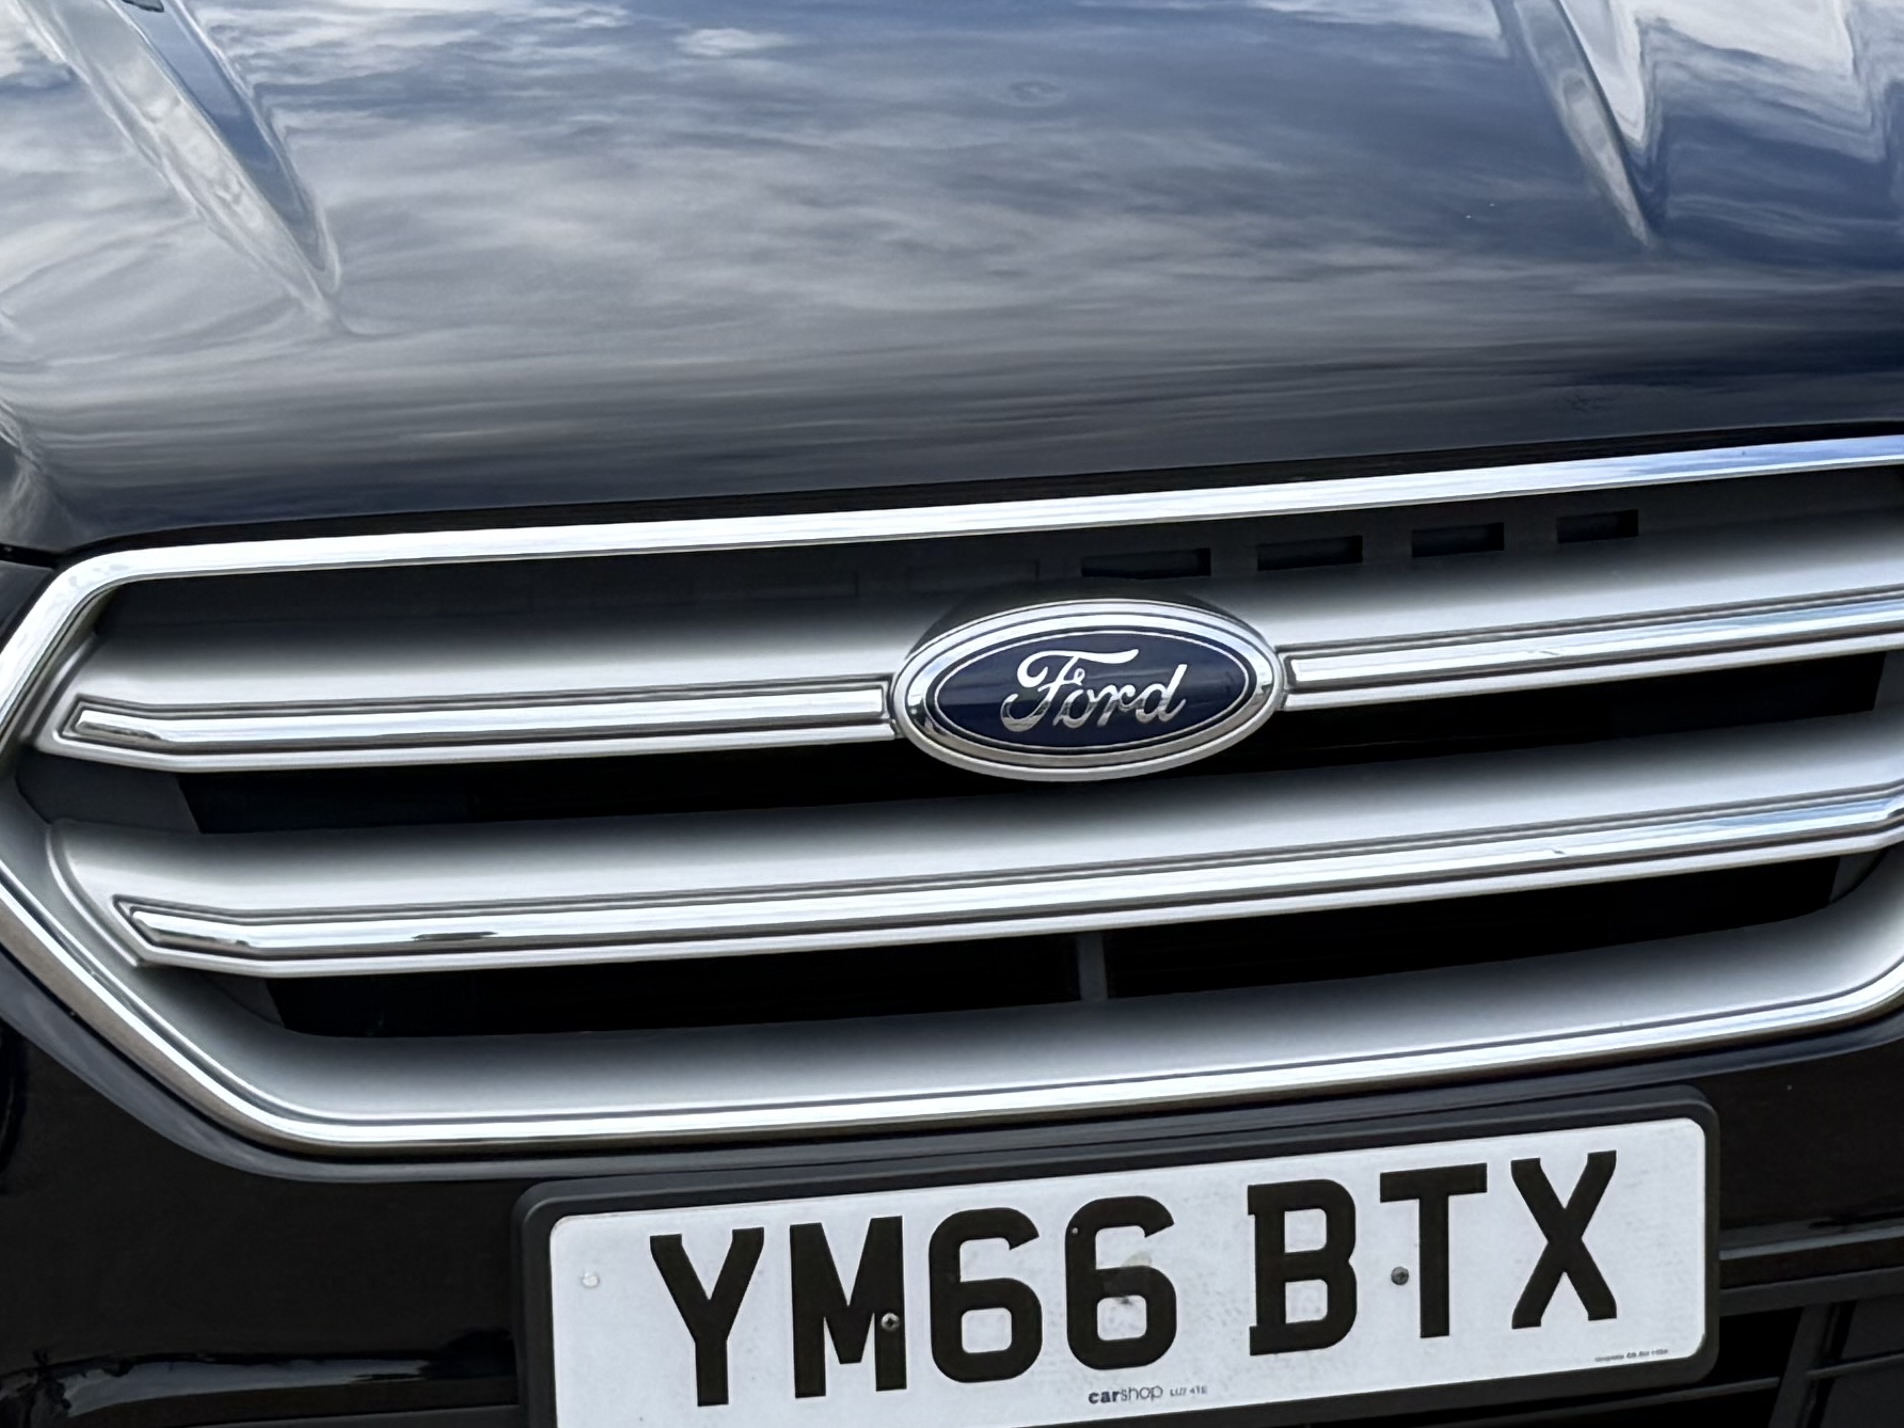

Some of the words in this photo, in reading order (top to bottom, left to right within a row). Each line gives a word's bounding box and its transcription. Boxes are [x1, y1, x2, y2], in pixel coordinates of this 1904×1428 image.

[1000, 648, 1188, 733] Ford
[649, 1195, 1178, 1408] YM66
[1247, 1149, 1618, 1357] BTX
[1088, 1384, 1164, 1405] carshop
